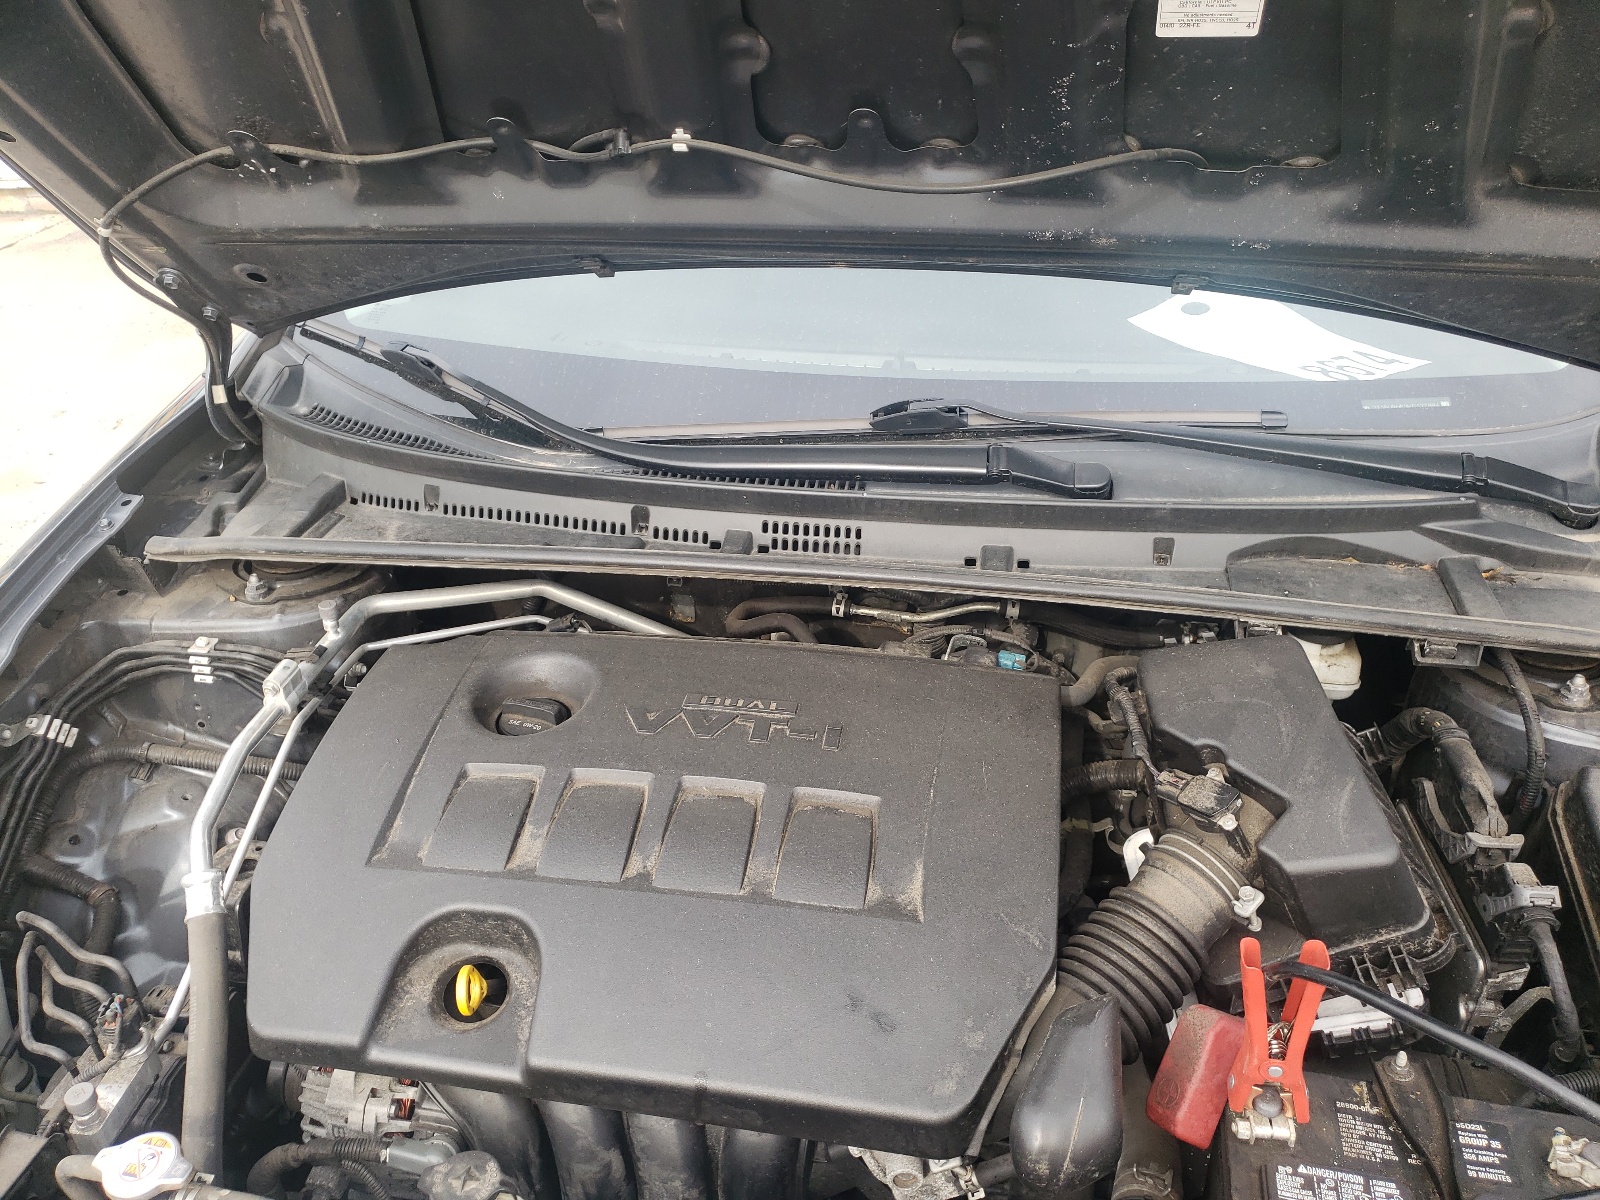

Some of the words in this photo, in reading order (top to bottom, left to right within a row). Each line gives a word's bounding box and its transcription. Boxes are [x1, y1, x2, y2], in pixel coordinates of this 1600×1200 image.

[699, 694, 787, 716] DUAL
[1459, 1136, 1488, 1147] GROUP
[1489, 1140, 1502, 1149] 35
[1478, 1155, 1500, 1164] AMPS
[1307, 1165, 1364, 1185] DANGER/POISON
[1477, 1172, 1512, 1183] MINUTES
